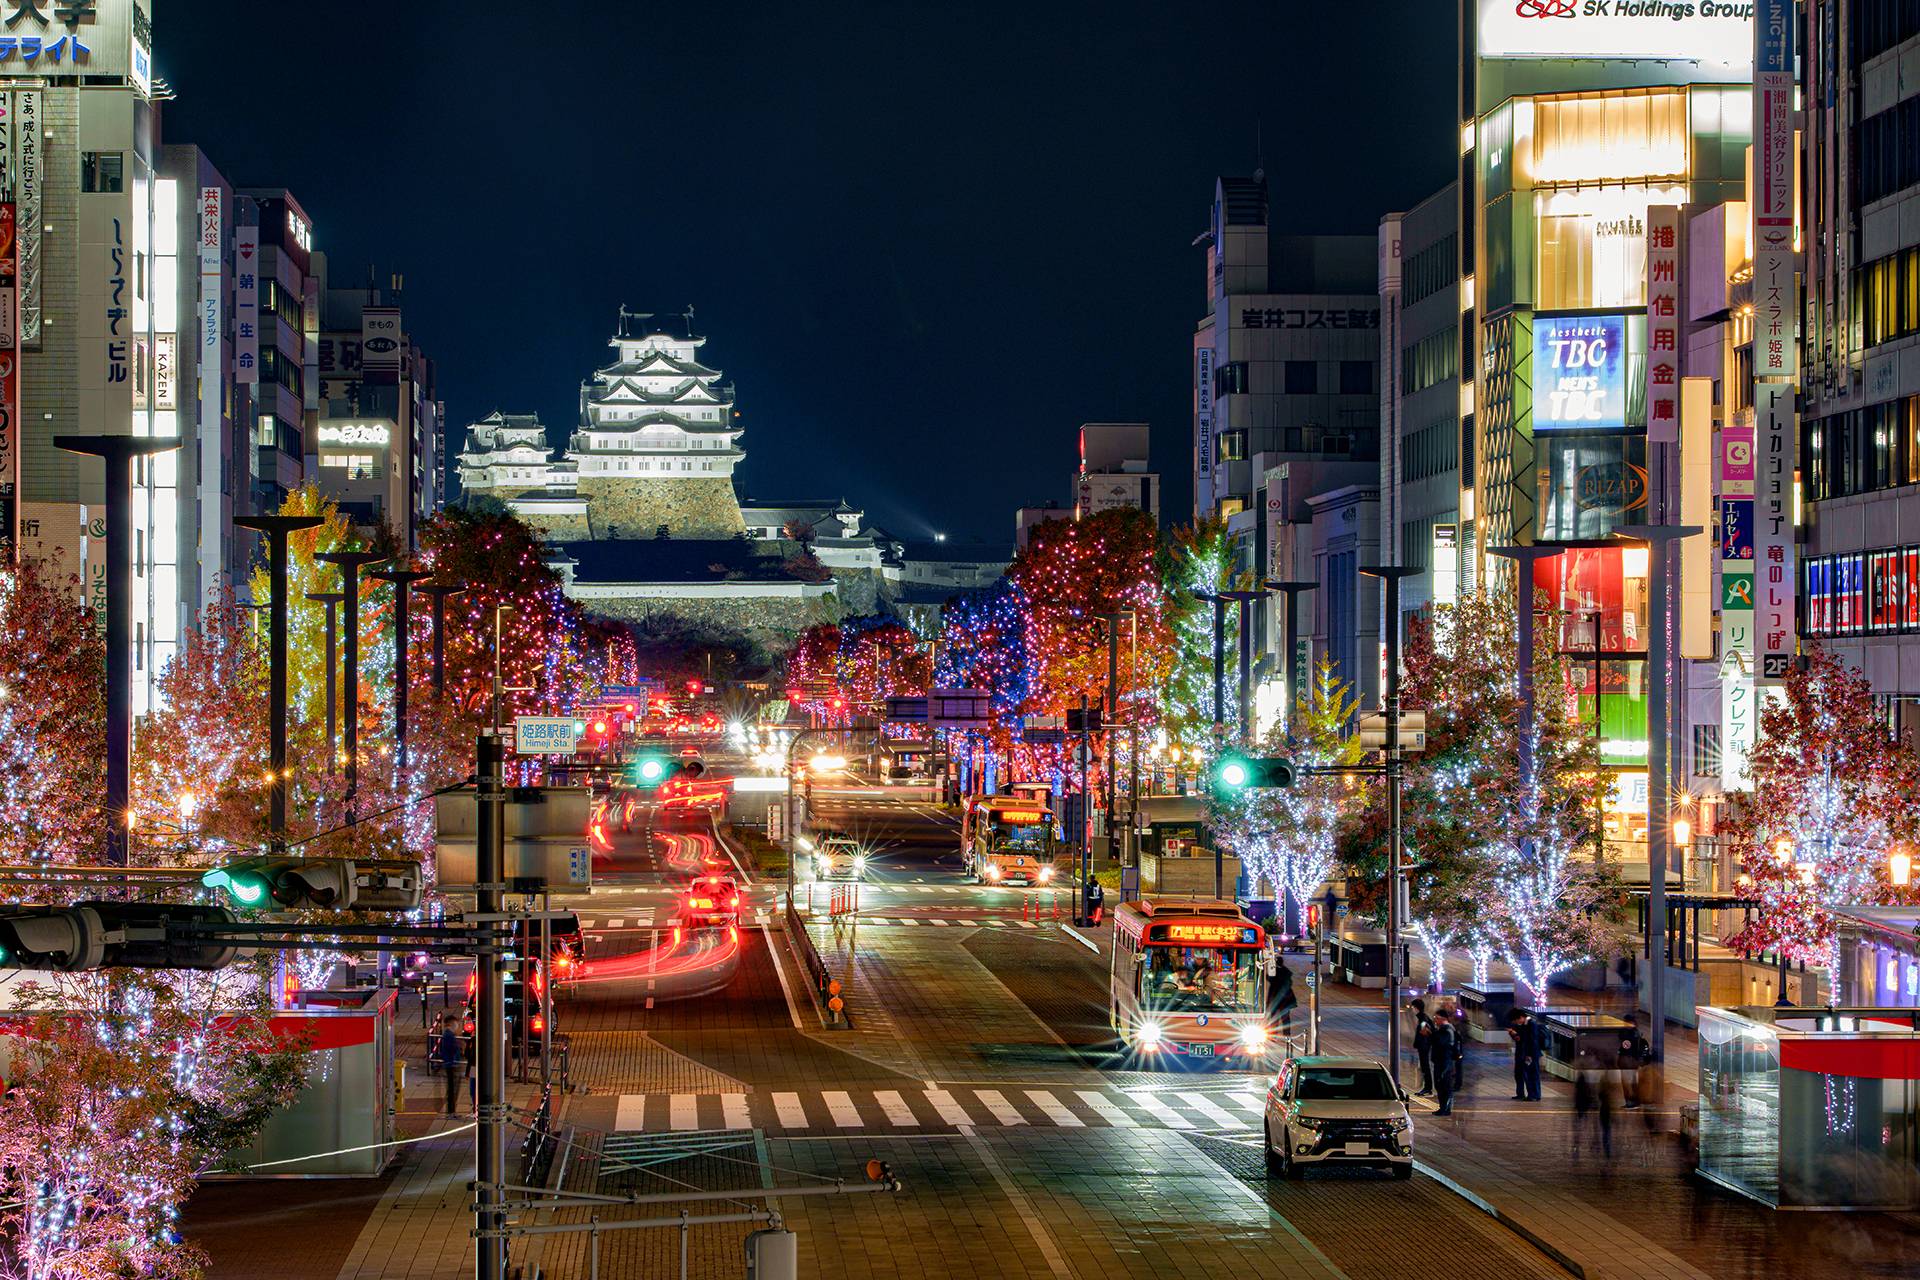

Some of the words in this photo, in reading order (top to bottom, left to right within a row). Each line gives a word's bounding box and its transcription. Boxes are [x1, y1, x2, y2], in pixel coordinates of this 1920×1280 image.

[1583, 1, 1608, 16] SK
[1614, 0, 1695, 21] Holdings
[23, 92, 34, 201] さあ、成人式に行こう
[1773, 89, 1787, 213] 湘南美容クリニック
[203, 189, 218, 246] 共栄火災
[206, 298, 217, 346] アフラック
[239, 273, 254, 369] 第一生命
[368, 320, 394, 330] きもの
[1550, 327, 1607, 338] Aesthetic
[1652, 225, 1675, 421] 播州信用金庫
[1548, 340, 1607, 369] TBC
[1585, 479, 1639, 495] RIZAP
[1768, 391, 1784, 536] トレカショップ
[1726, 502, 1737, 558] エルセーヌ
[1740, 547, 1752, 559] 4F
[92, 564, 107, 640] りそな銀
[1767, 545, 1786, 650] 竜のしっぽ
[1765, 659, 1788, 675] 2F
[522, 724, 571, 739] 姫路駅前
[525, 739, 551, 748] Himeji
